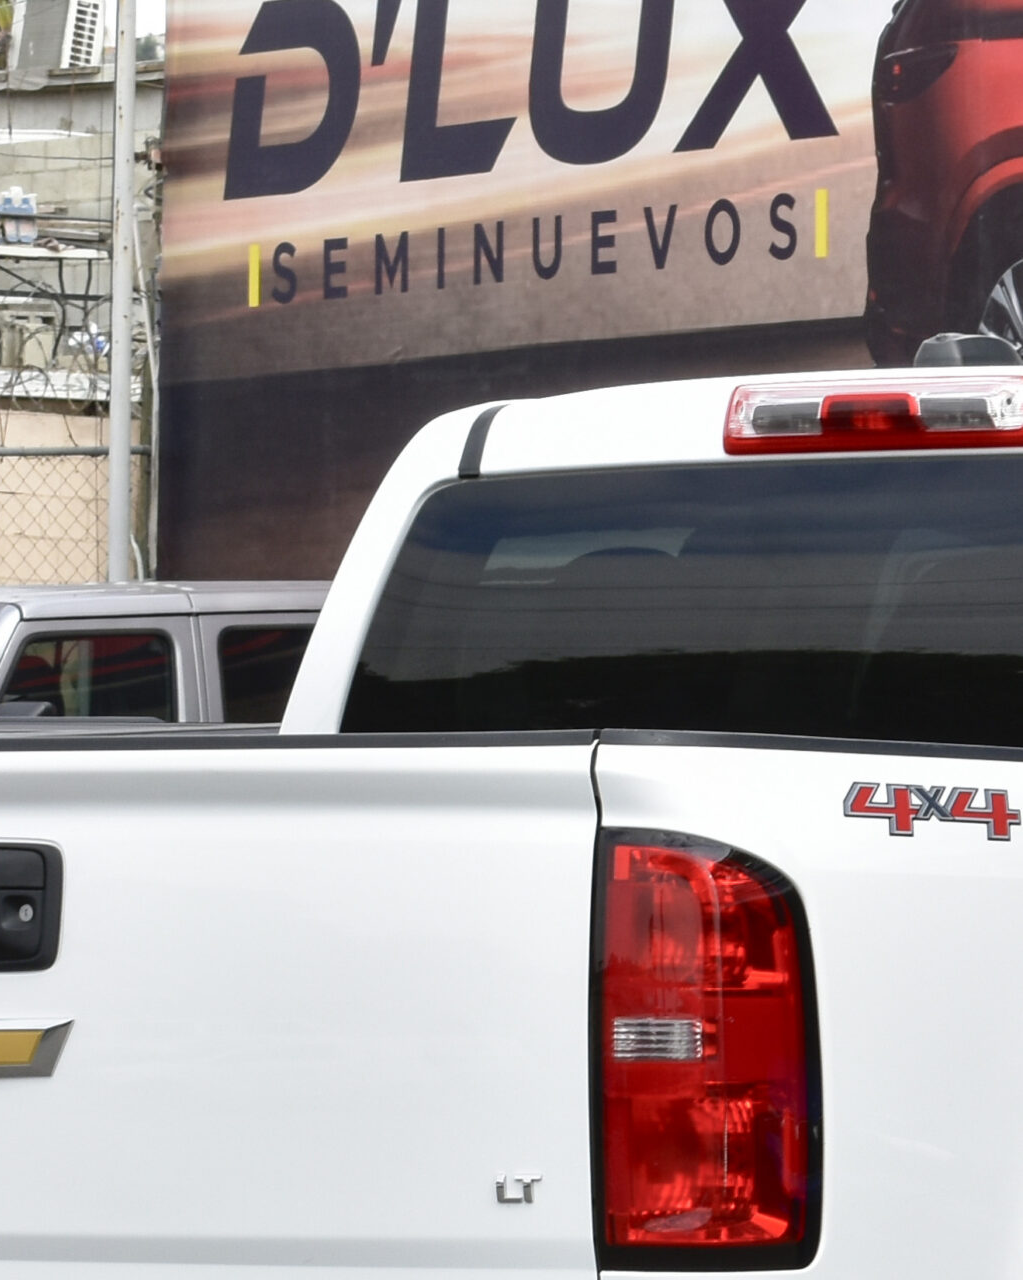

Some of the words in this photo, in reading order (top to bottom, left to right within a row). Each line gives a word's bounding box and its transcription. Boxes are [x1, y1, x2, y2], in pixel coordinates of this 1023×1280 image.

[223, 0, 839, 200] D'LUX
[271, 192, 798, 305] SEMINUEVOS
[495, 1173, 543, 1204] LT
